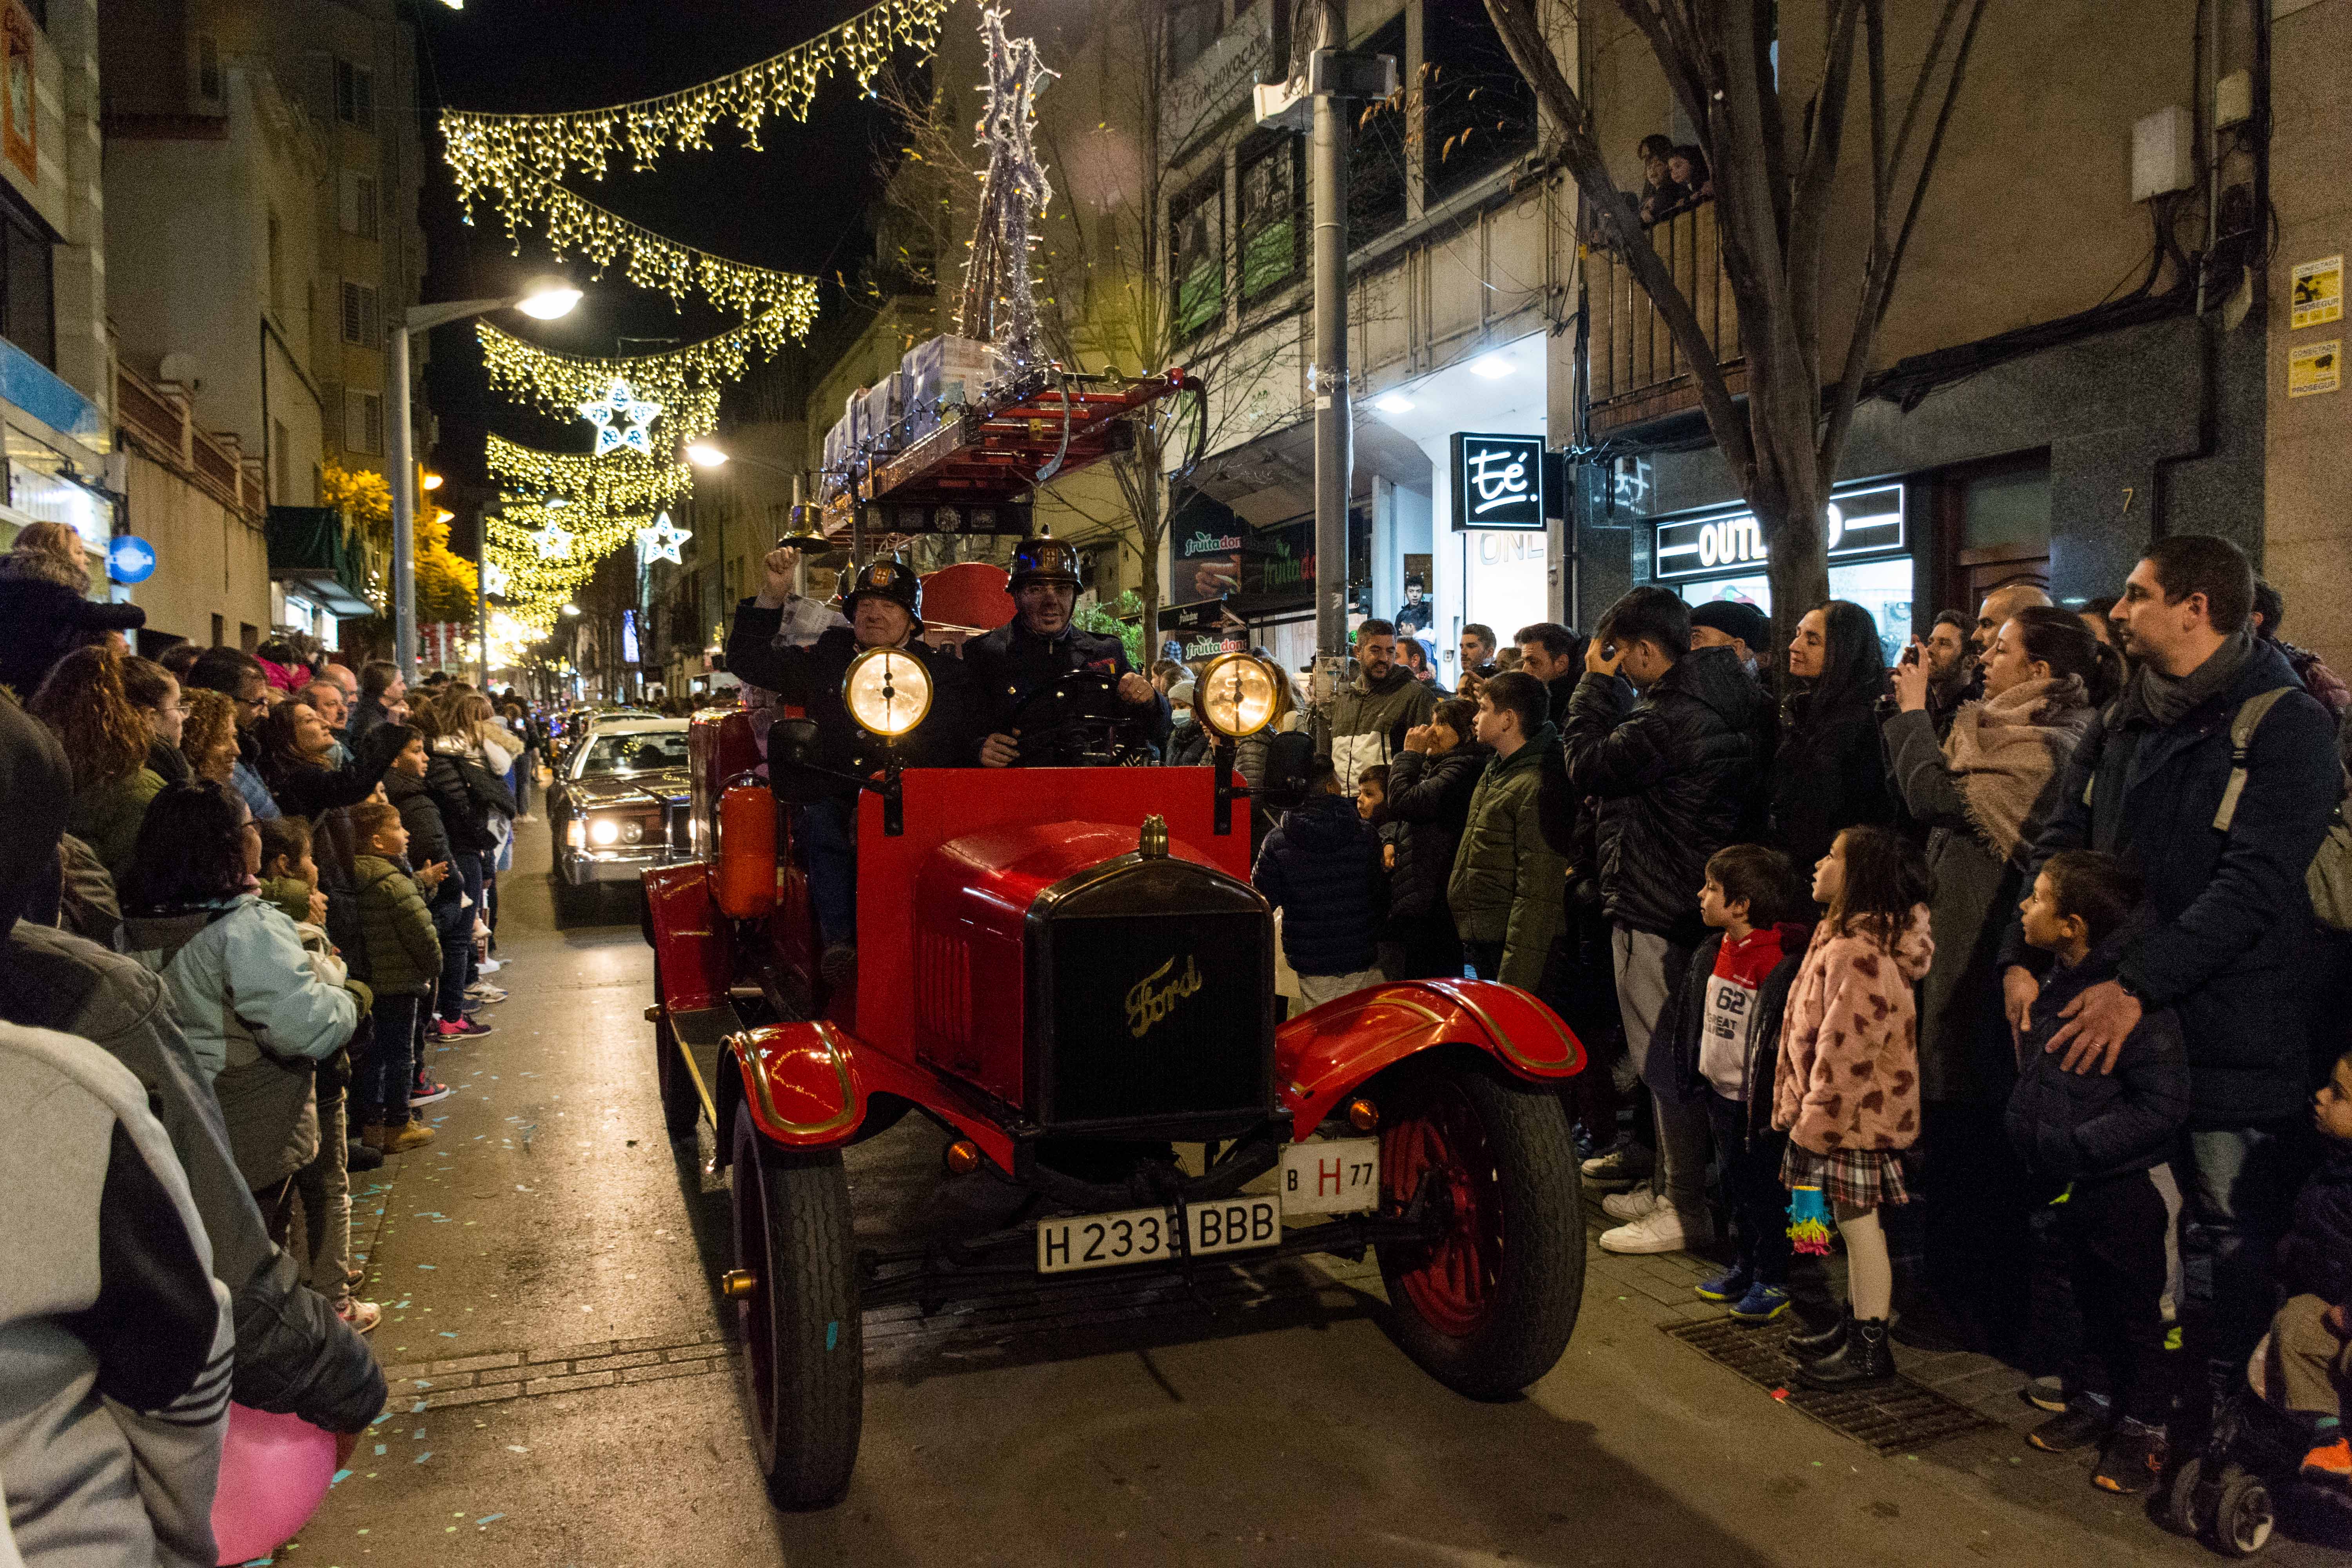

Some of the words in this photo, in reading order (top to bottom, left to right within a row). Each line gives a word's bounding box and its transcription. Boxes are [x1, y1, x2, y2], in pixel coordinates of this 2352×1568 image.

[2294, 297, 2339, 313] PROSEGUR
[2292, 380, 2336, 393] PROSEGUR
[2122, 488, 2133, 513] 7
[1125, 955, 1202, 1038] Ford
[1716, 986, 1746, 1016] 62
[1288, 1169, 1298, 1191] B
[1319, 1157, 1341, 1196] H
[1350, 1163, 1373, 1186] 77
[1046, 1226, 1070, 1266] H
[1200, 1203, 1273, 1248] BBB
